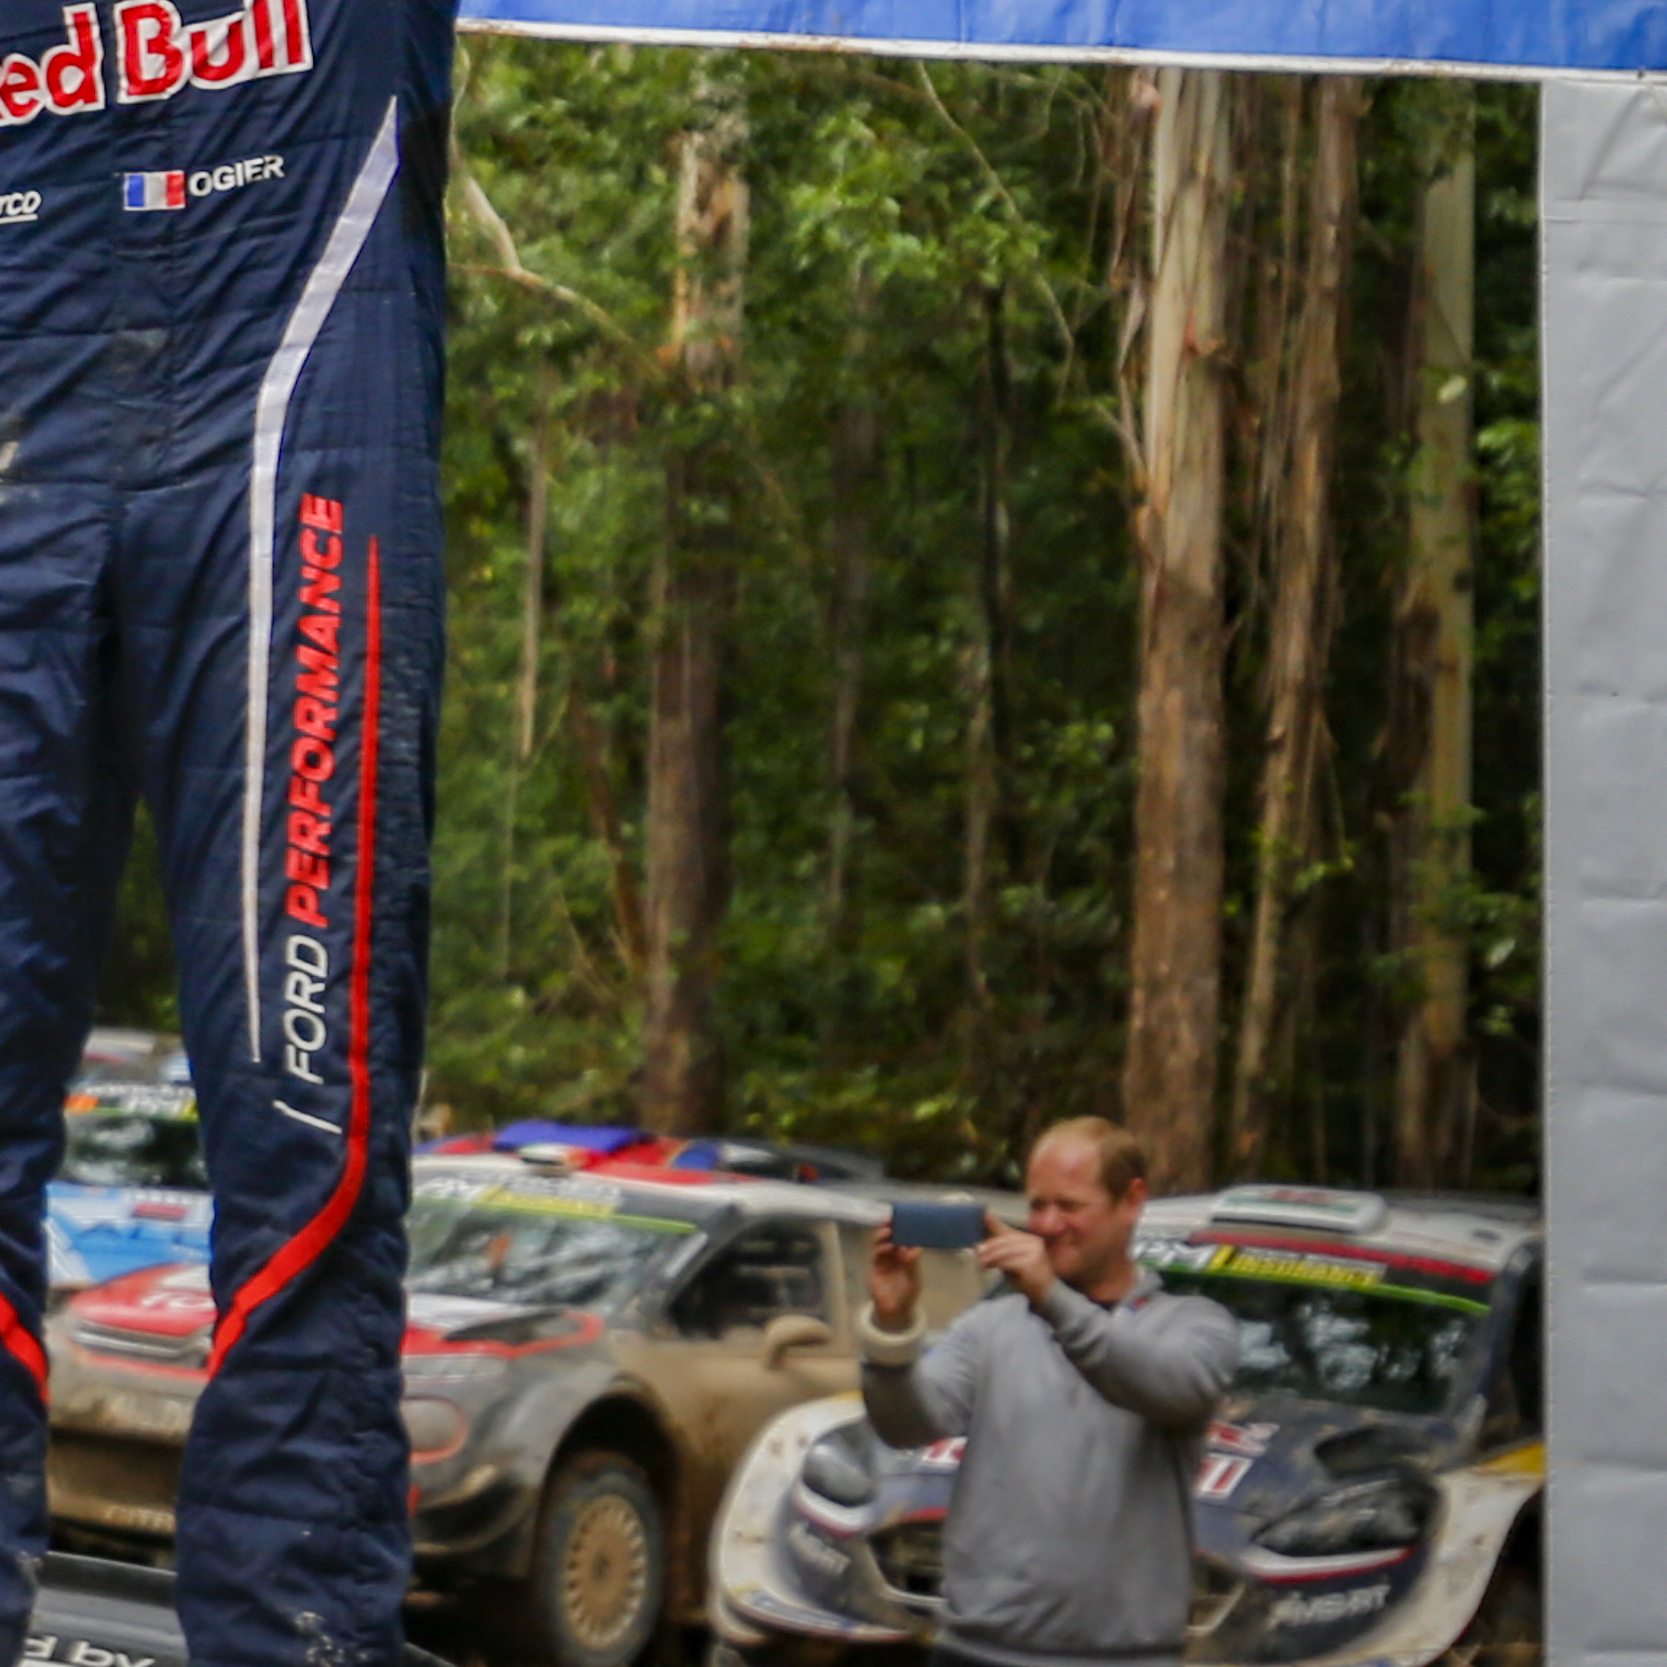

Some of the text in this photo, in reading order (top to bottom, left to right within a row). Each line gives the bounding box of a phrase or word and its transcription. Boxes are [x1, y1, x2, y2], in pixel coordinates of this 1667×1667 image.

[188, 154, 285, 198] OGIER
[283, 493, 345, 1085] FORD PERFORMANCE
